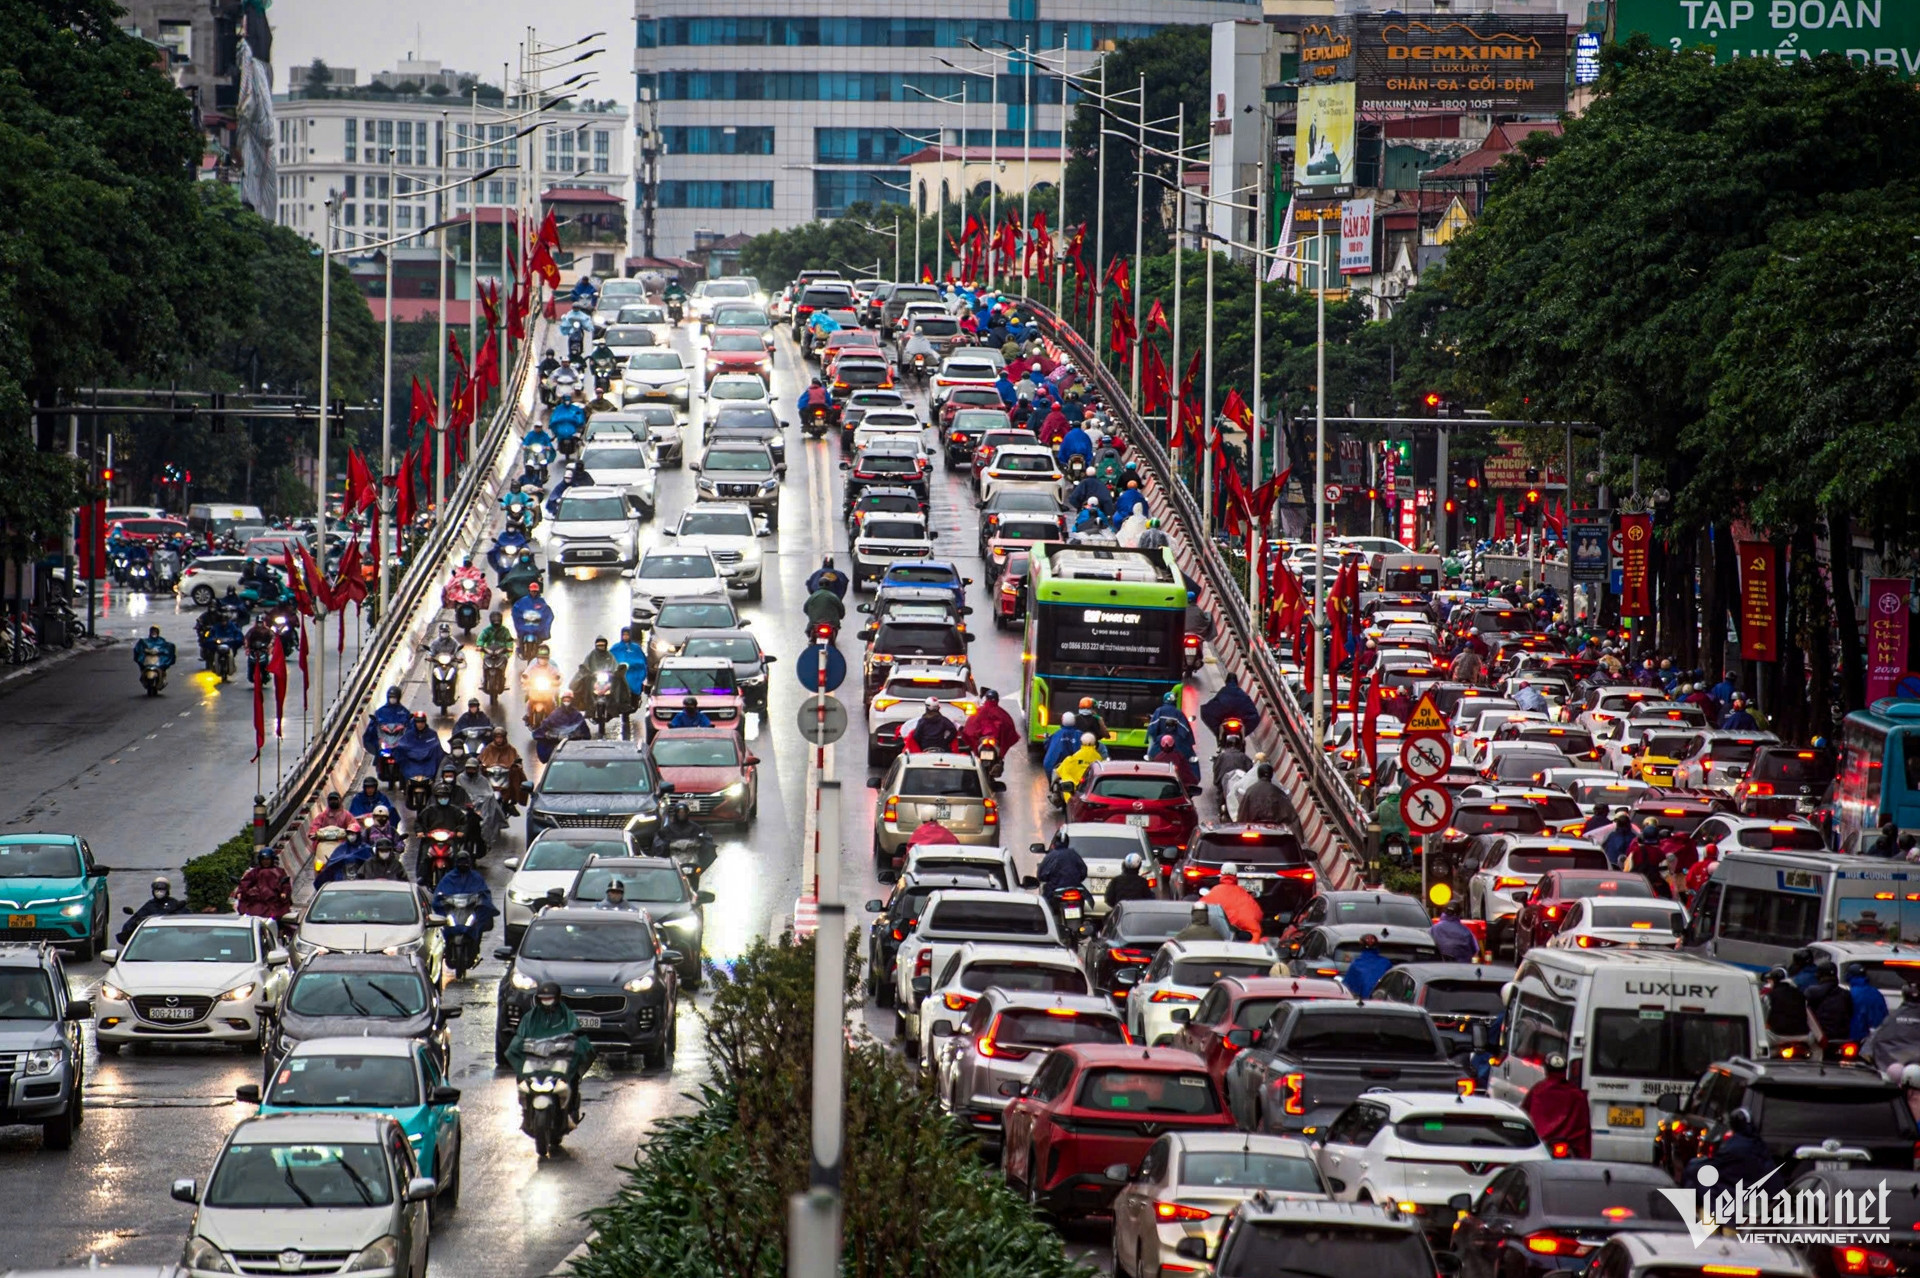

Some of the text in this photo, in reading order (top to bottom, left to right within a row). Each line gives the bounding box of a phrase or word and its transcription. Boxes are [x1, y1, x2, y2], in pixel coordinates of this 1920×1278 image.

[1680, 1, 1754, 38] TẠP
[1302, 45, 1350, 62] DEMXINH
[1387, 45, 1536, 60] DEMXINH
[1432, 64, 1490, 73] LUXURY
[1386, 76, 1428, 91] CHĂN
[1436, 79, 1458, 91] GA
[1468, 74, 1496, 91] GỐI
[1504, 76, 1534, 93] ĐỆM
[1441, 100, 1467, 108] 1800
[1874, 666, 1901, 674] 2026
[1420, 708, 1431, 716] ĐI
[1411, 716, 1440, 730] CHẬM
[1625, 981, 1719, 999] LUXURY
